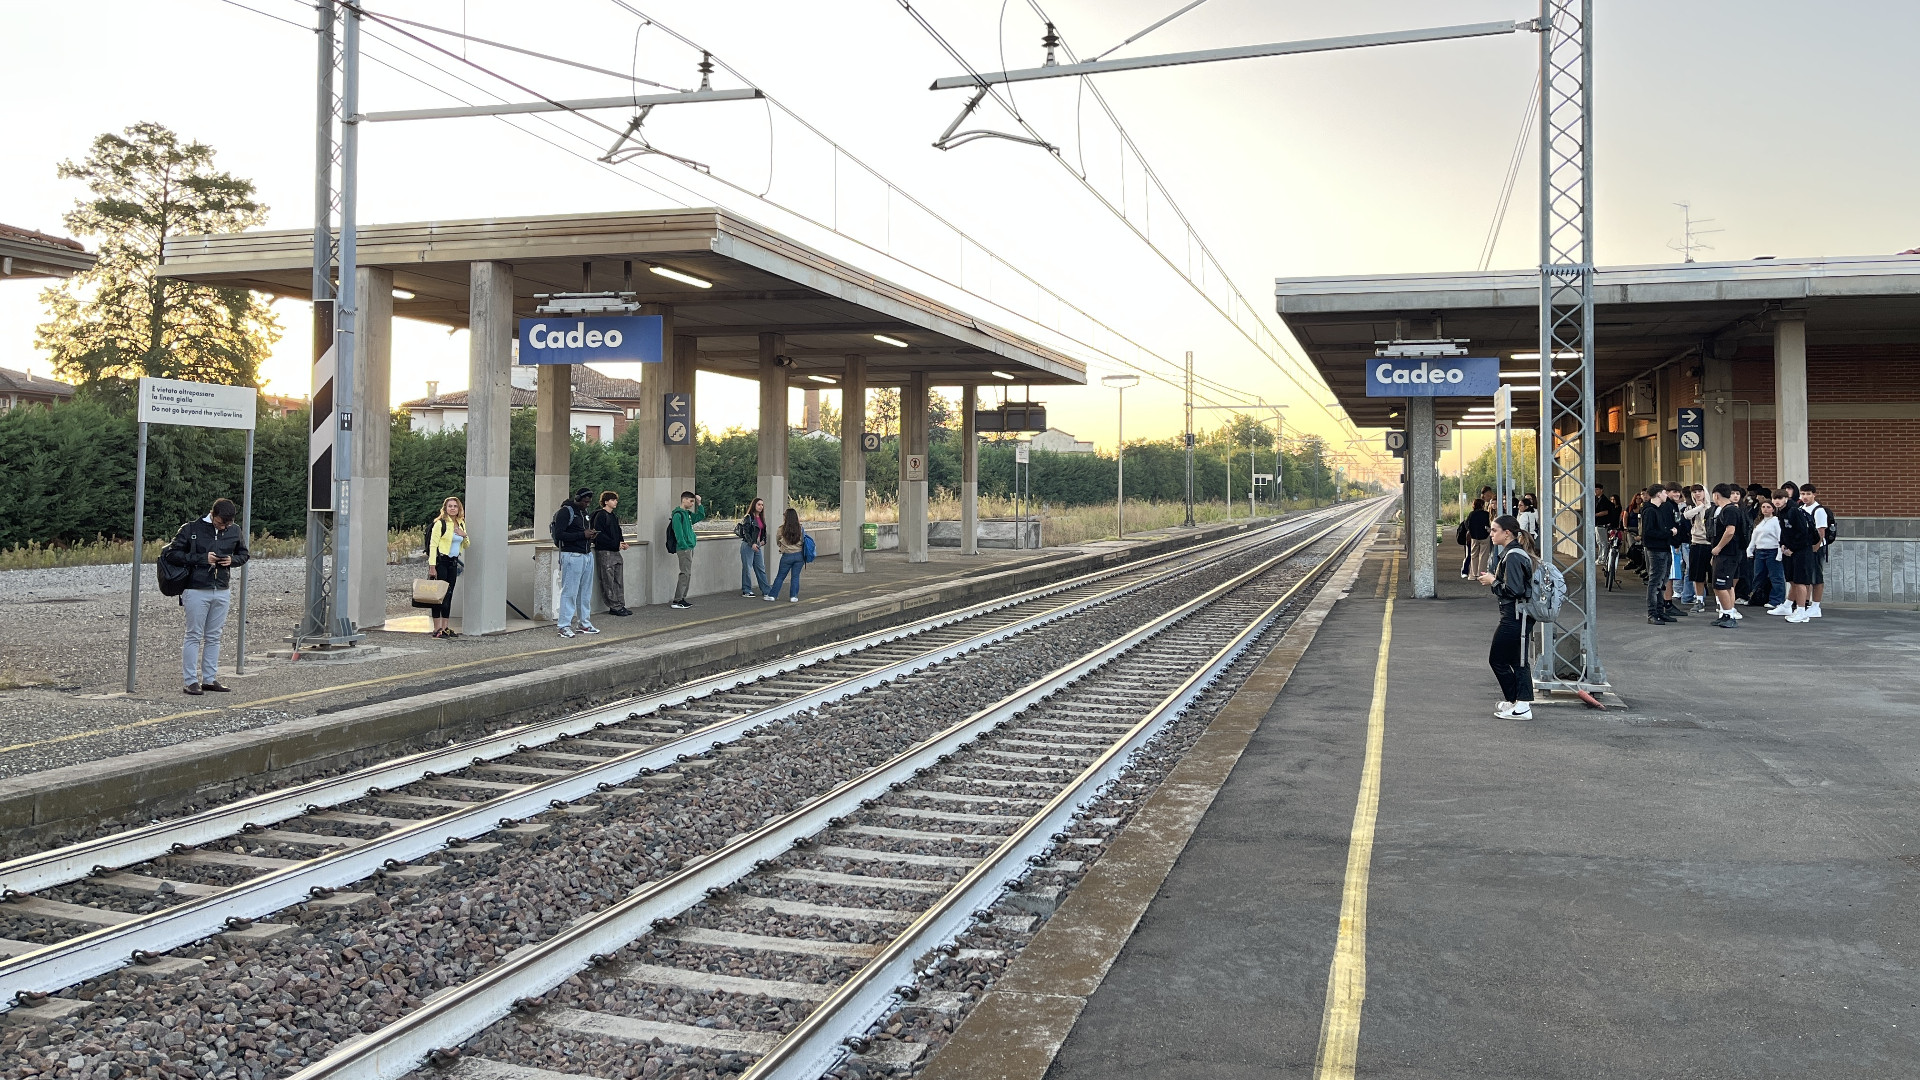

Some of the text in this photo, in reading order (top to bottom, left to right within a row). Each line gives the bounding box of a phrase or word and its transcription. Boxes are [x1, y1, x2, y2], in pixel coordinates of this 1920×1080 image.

[528, 321, 623, 349] Cadeo
[1375, 362, 1464, 384] Cadeo
[178, 388, 215, 398] oltrepassare
[181, 407, 203, 416] beyond
[213, 410, 233, 418] yellow
[867, 437, 875, 447] 2
[1392, 435, 1399, 446] 1
